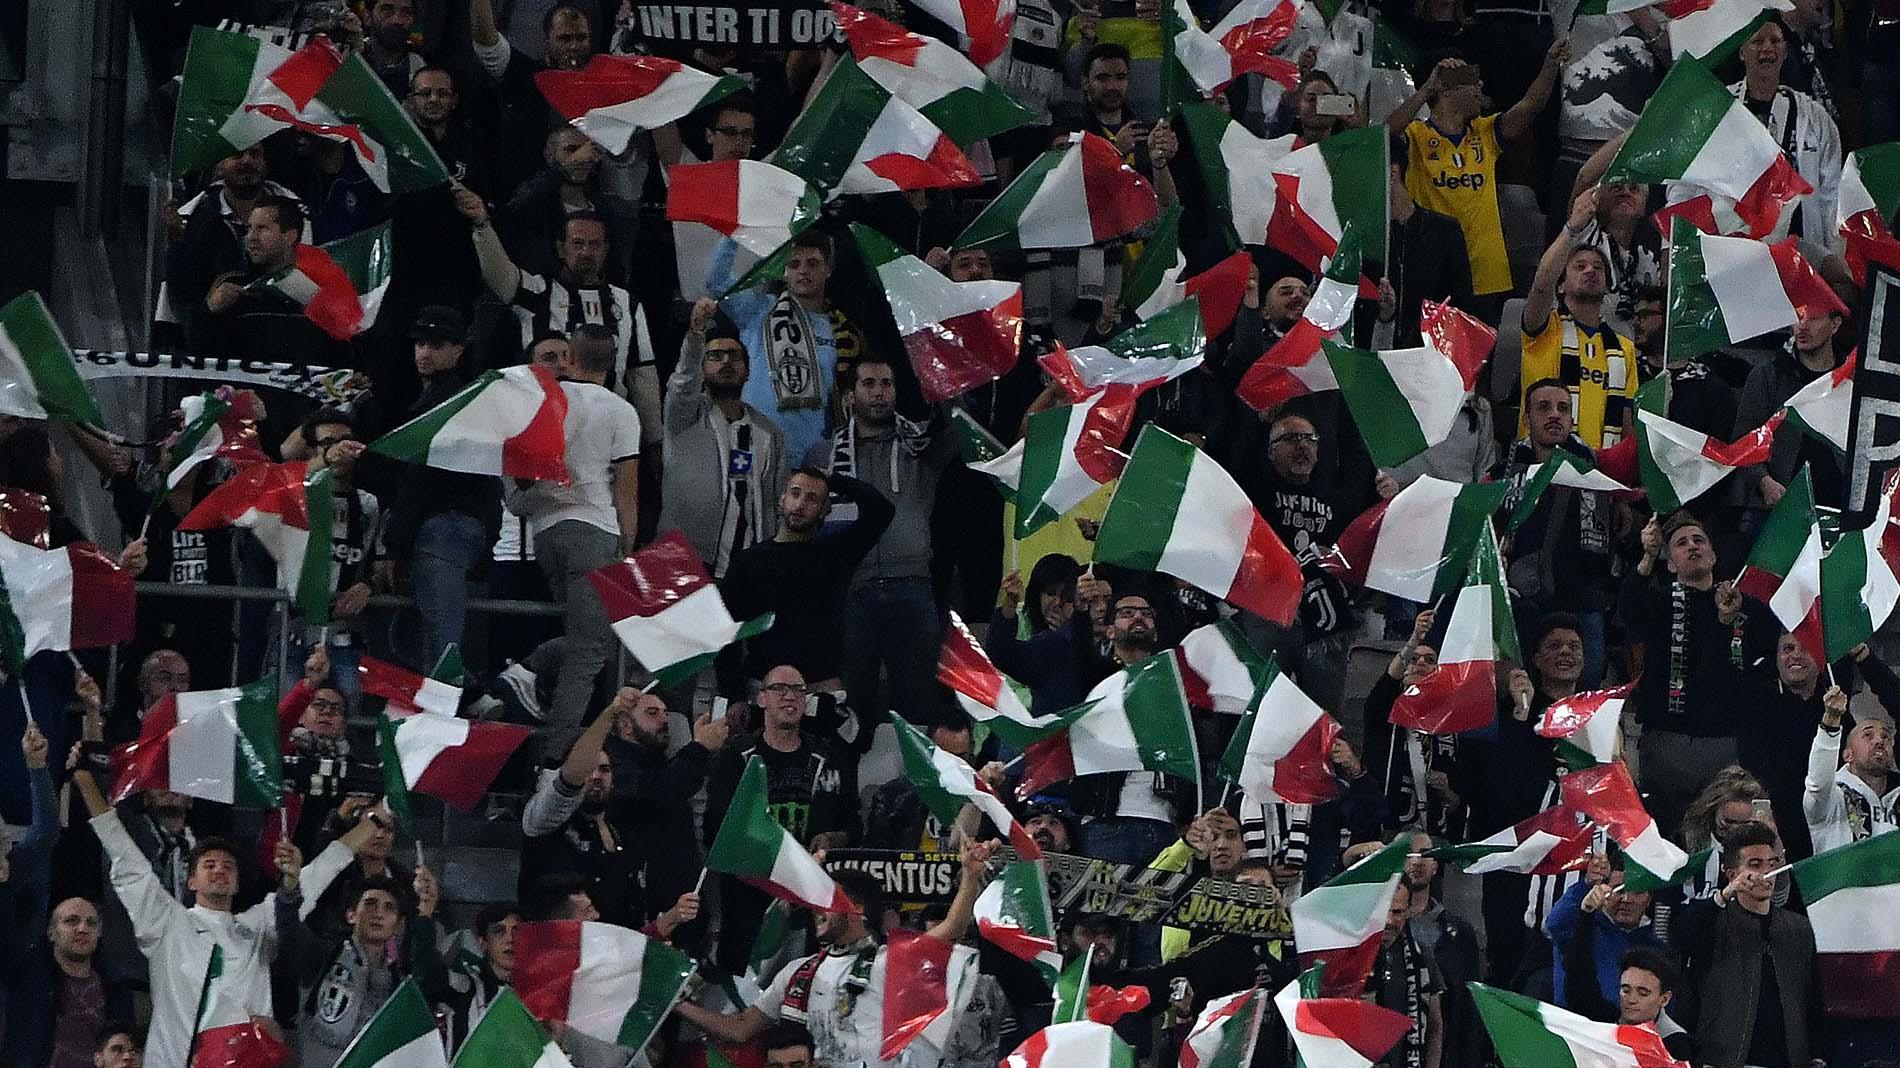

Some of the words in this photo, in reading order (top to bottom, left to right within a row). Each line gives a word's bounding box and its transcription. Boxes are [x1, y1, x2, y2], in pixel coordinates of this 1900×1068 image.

[638, 5, 739, 43] INTER
[747, 8, 780, 44] TI
[1432, 170, 1485, 192] Jeep
